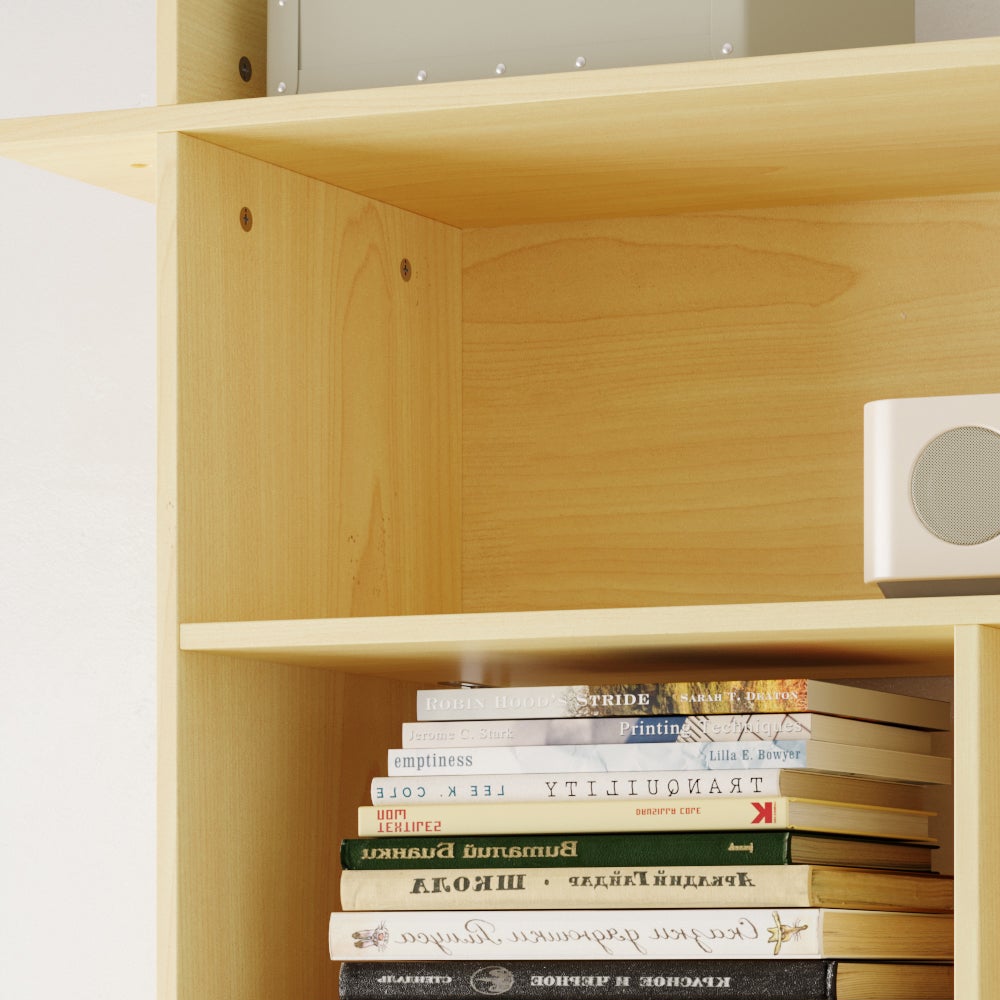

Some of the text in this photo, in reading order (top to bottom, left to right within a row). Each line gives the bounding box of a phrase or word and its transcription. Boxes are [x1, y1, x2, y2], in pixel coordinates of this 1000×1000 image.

[426, 693, 650, 712] ROBIN HOOD'S STRIDE
[680, 692, 723, 703] SARAH
[729, 692, 741, 702] T.
[408, 730, 456, 742] Jerome
[460, 729, 474, 740] C.
[619, 718, 802, 738] Printing Techniques
[394, 753, 473, 770] emptiness
[709, 749, 801, 763] Lilla E. Bowyer
